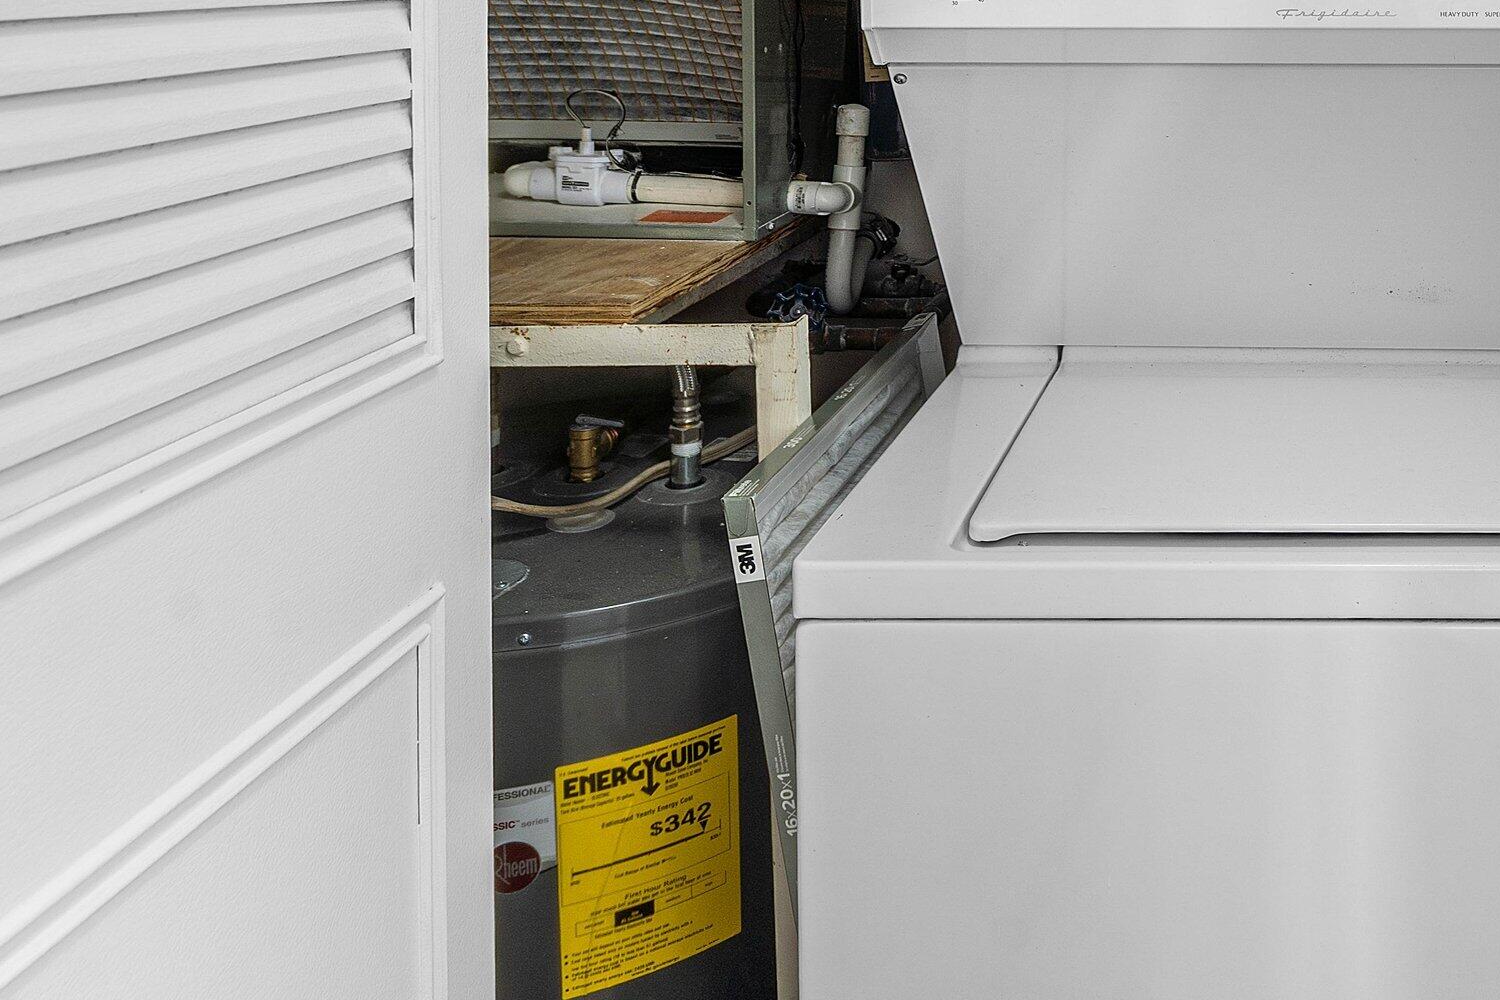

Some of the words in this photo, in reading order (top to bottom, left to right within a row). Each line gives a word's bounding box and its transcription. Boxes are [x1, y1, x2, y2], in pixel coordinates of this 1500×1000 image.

[1275, 8, 1397, 21] Frigidaire
[736, 544, 756, 575] 3M
[563, 733, 722, 800] ENERGYGUIDE
[650, 801, 712, 836] $342
[657, 801, 678, 812] Energy
[777, 773, 797, 836] 16x20x1
